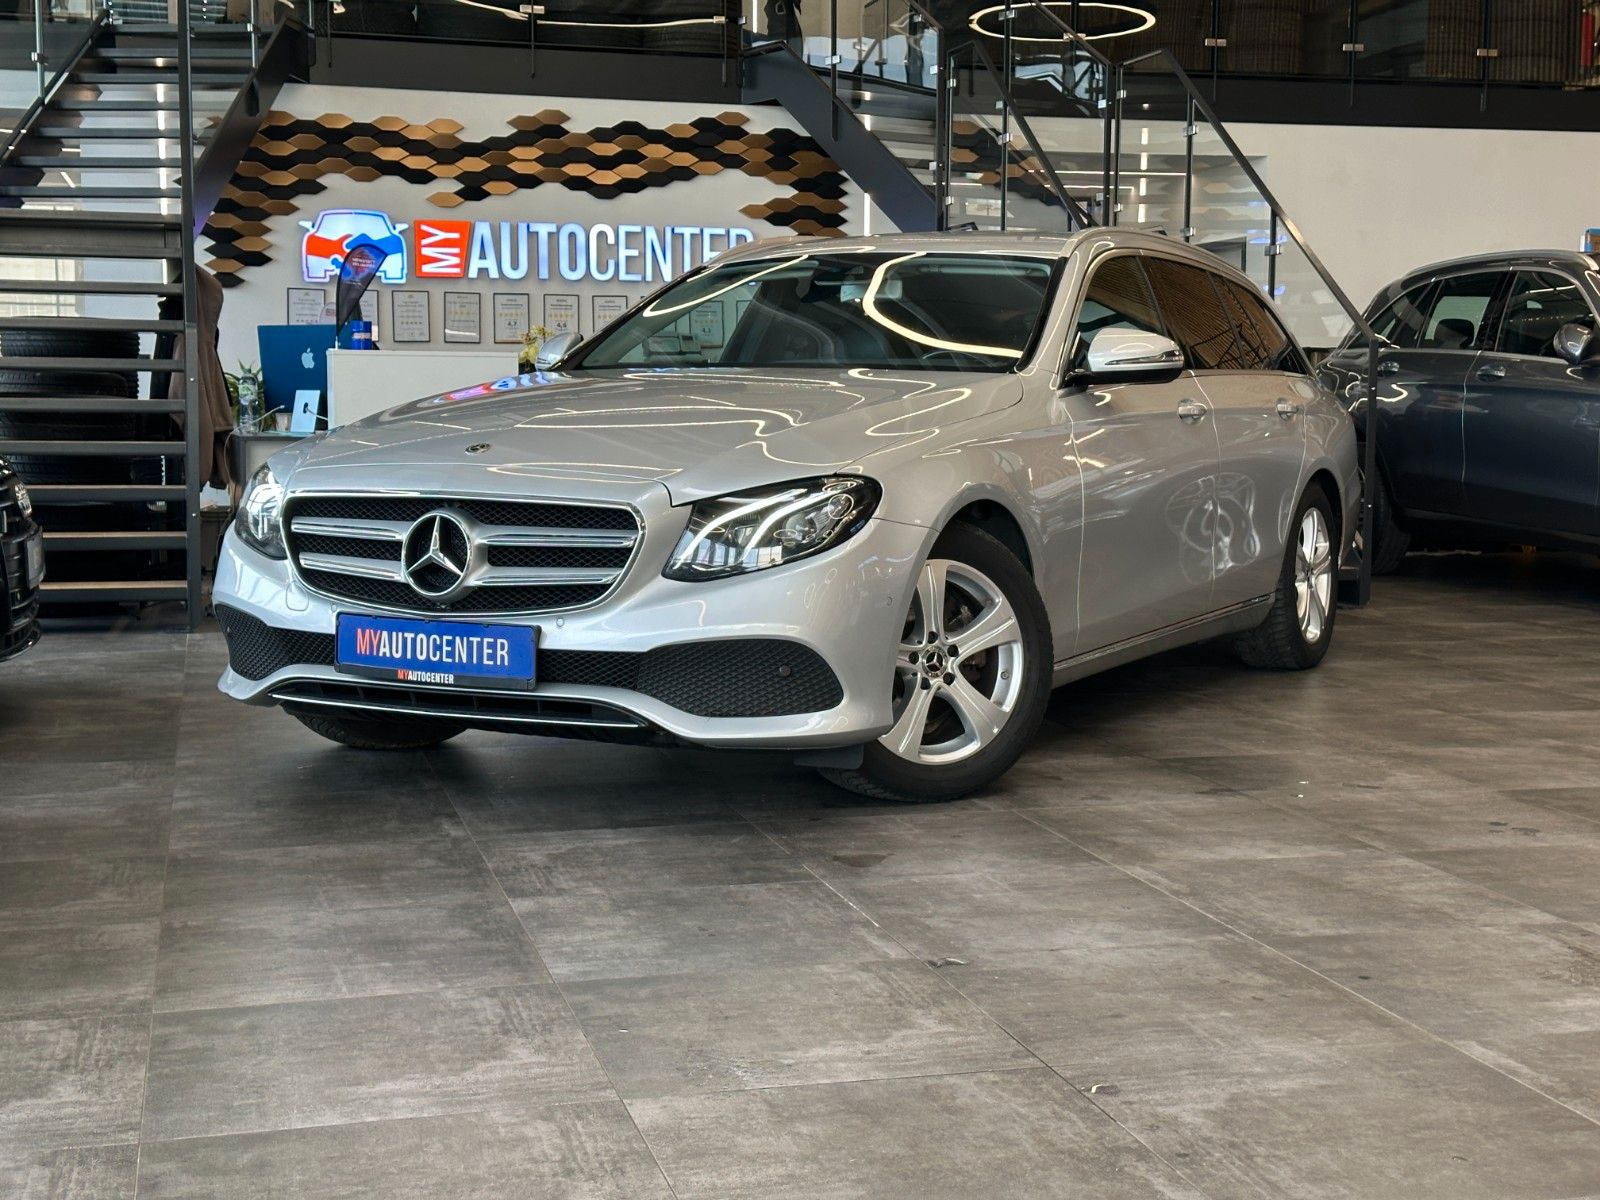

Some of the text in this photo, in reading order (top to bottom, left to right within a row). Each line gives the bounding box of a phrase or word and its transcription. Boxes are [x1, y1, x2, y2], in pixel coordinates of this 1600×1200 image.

[420, 224, 461, 273] MY
[356, 627, 509, 666] MYAUTOCENTER
[397, 669, 454, 684] MYAUTOCENTER
